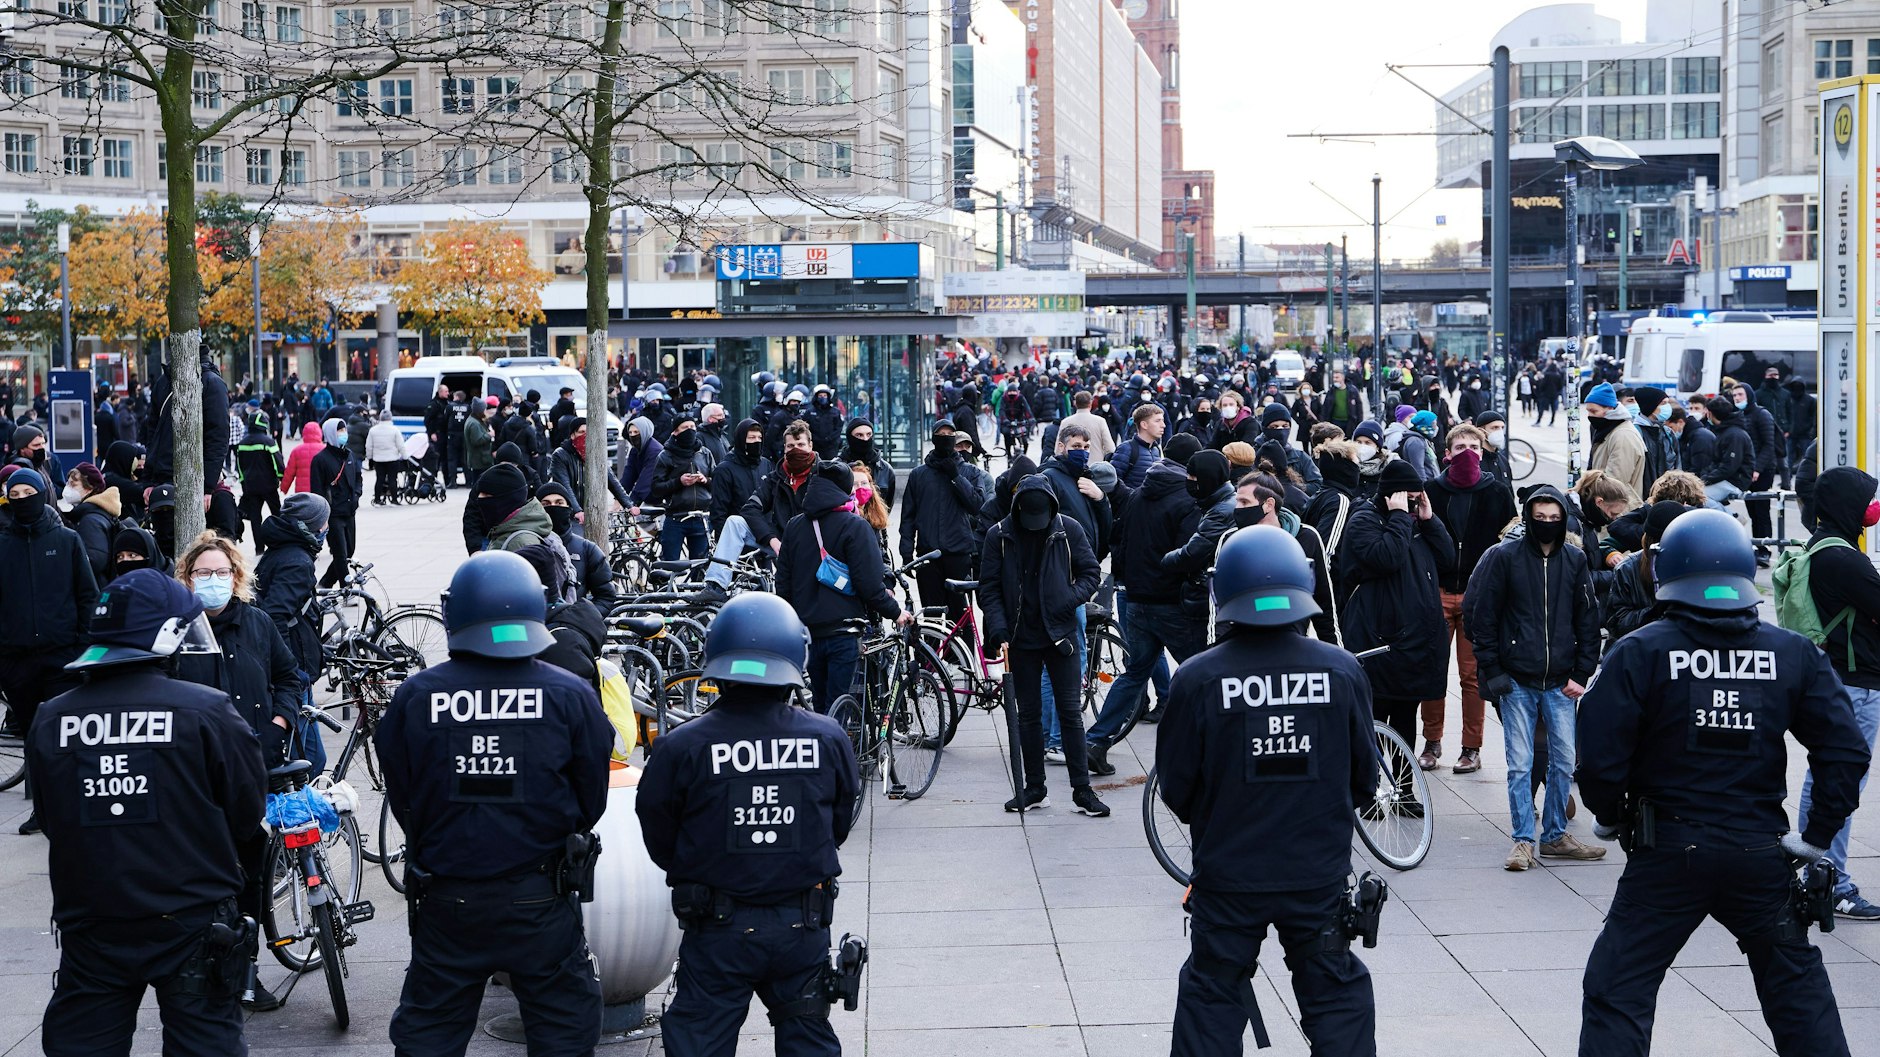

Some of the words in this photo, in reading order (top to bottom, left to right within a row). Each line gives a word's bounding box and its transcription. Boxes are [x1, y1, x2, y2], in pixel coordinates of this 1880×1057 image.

[1837, 114, 1849, 135] 12
[1838, 184, 1848, 256] Berlin.
[721, 248, 745, 278] U
[809, 249, 826, 260] U2
[809, 264, 826, 275] U5
[1748, 267, 1786, 278] POLIZEI
[1838, 265, 1848, 308] Und
[987, 297, 1002, 309] 22
[1005, 297, 1021, 309] 23
[1022, 297, 1038, 309] 24
[1838, 342, 1848, 380] Sie.
[1838, 388, 1848, 421] für
[1838, 429, 1848, 466] Gut
[1669, 649, 1777, 681] POLIZEI
[1221, 673, 1331, 709] POLIZEI
[1713, 690, 1740, 709] BE
[430, 688, 543, 724] POLIZEI
[59, 711, 174, 748] POLIZEI
[1268, 715, 1296, 734] BE
[1696, 709, 1756, 730] 31111
[471, 735, 500, 754] BE
[1252, 734, 1312, 756] 31114
[99, 754, 129, 775] BE
[455, 756, 518, 775] 31121
[711, 738, 820, 775] POLIZEI
[83, 775, 149, 797] 31002
[751, 785, 779, 805] BE
[734, 806, 795, 826] 31120
